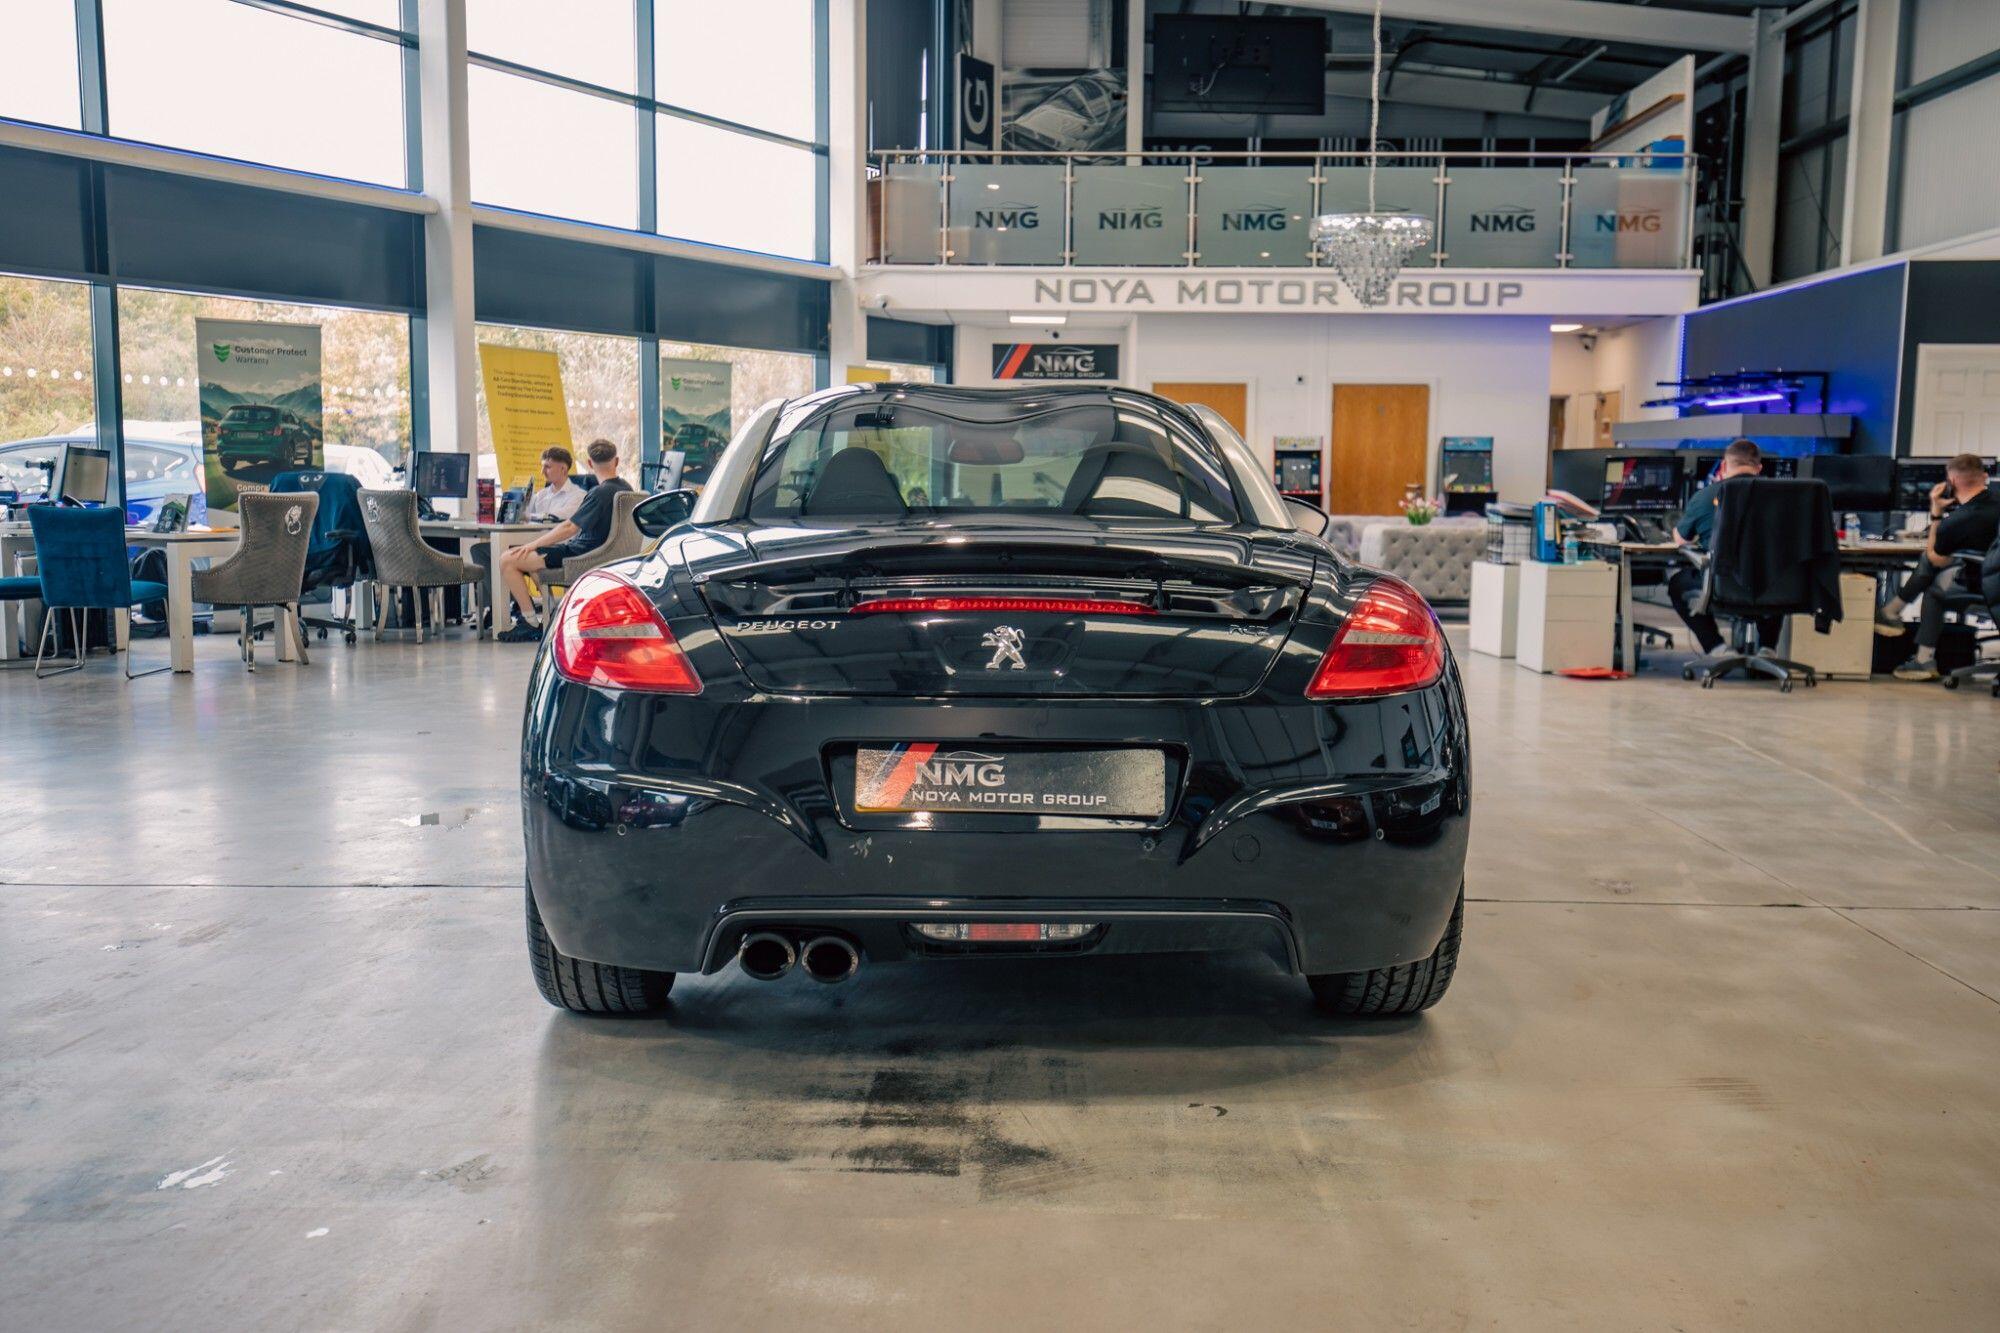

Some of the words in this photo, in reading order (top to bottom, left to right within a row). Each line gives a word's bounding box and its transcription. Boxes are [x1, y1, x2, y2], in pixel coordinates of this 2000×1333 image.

[975, 210, 1039, 228] NMG
[1099, 211, 1162, 229] NMG
[1222, 213, 1286, 231] NMG
[1470, 214, 1536, 232] NMG
[1596, 214, 1661, 232] NMG
[1035, 278, 1155, 304] NOYA
[1178, 279, 1338, 305] MOTOR
[234, 345, 275, 355] Customer
[276, 347, 307, 356] Protect
[235, 356, 269, 365] Warranty
[1033, 354, 1095, 372] NMG
[736, 620, 841, 633] PEUGEOT
[914, 761, 1006, 787] NMG
[912, 790, 962, 803] NOYA
[969, 792, 1034, 804] MOTOR
[1042, 794, 1108, 806] GROUP
